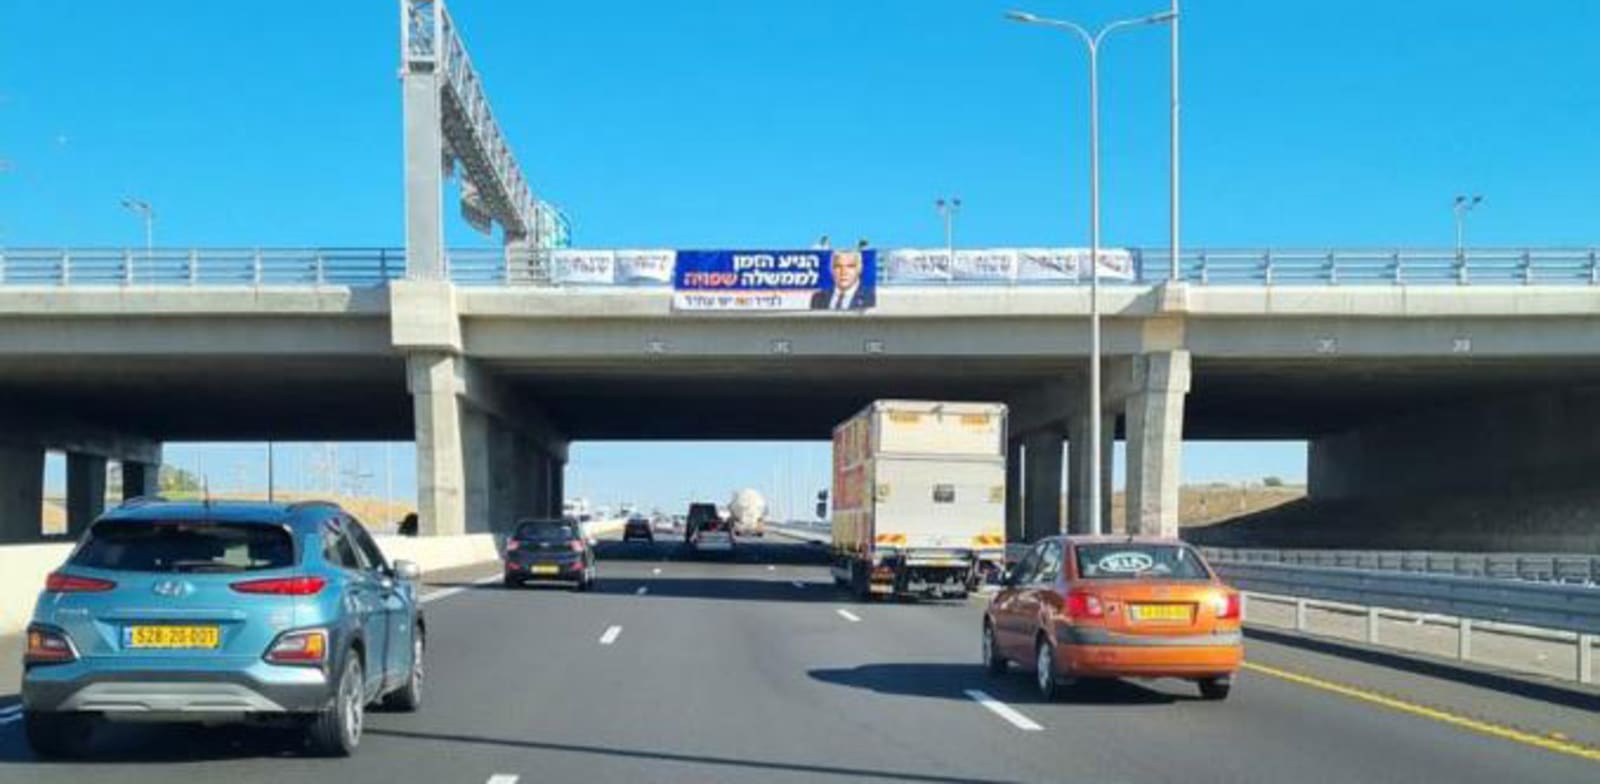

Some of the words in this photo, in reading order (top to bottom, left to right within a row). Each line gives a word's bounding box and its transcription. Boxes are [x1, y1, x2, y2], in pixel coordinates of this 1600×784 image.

[733, 255, 775, 272] הזמן
[778, 255, 820, 268] הגיע
[684, 272, 738, 287] שפויה
[741, 269, 820, 286] לממשלה
